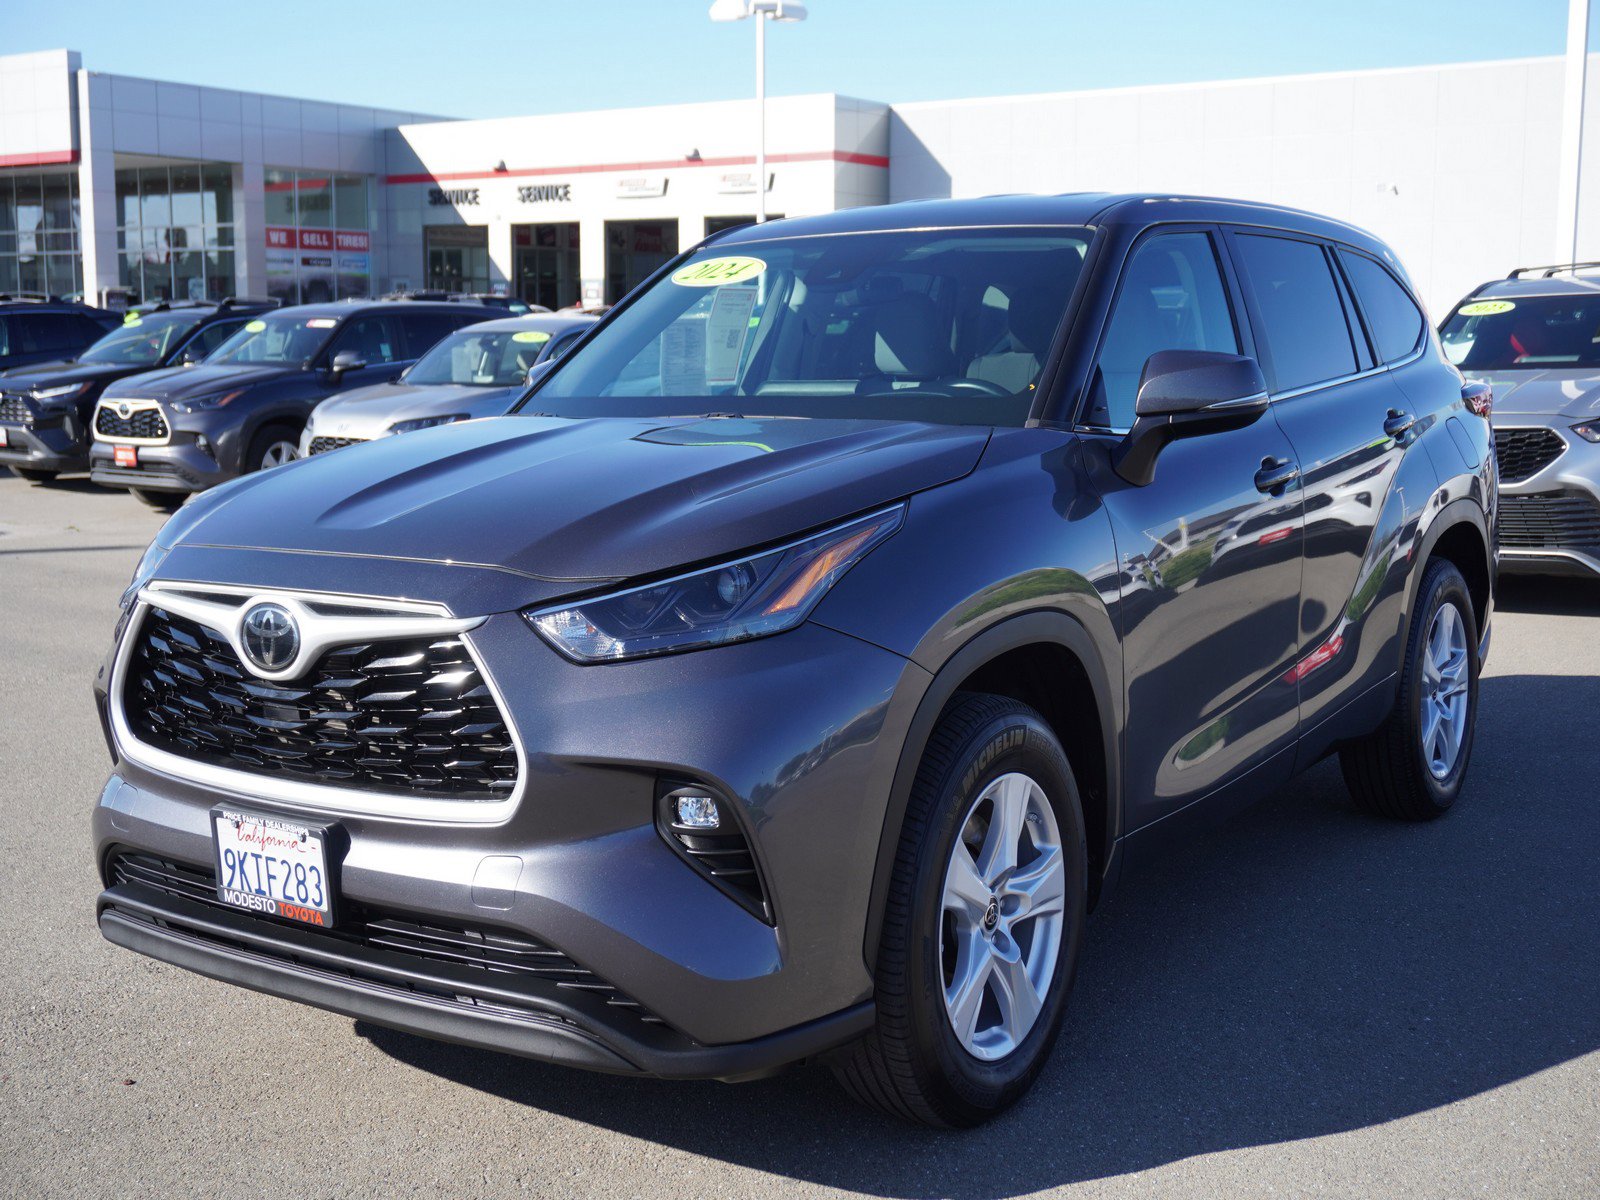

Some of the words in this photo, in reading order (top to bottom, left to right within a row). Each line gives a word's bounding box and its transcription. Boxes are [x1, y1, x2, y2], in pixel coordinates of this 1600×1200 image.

[517, 184, 571, 204] SERVICE
[269, 231, 287, 245] WE
[302, 232, 329, 247] SELL
[679, 262, 756, 280] 2024
[962, 729, 1024, 795] MICHELIN
[237, 820, 306, 853] California
[224, 848, 323, 908] 9KIF283
[223, 889, 276, 914] MODESTO
[278, 901, 324, 925] TOYOTA
